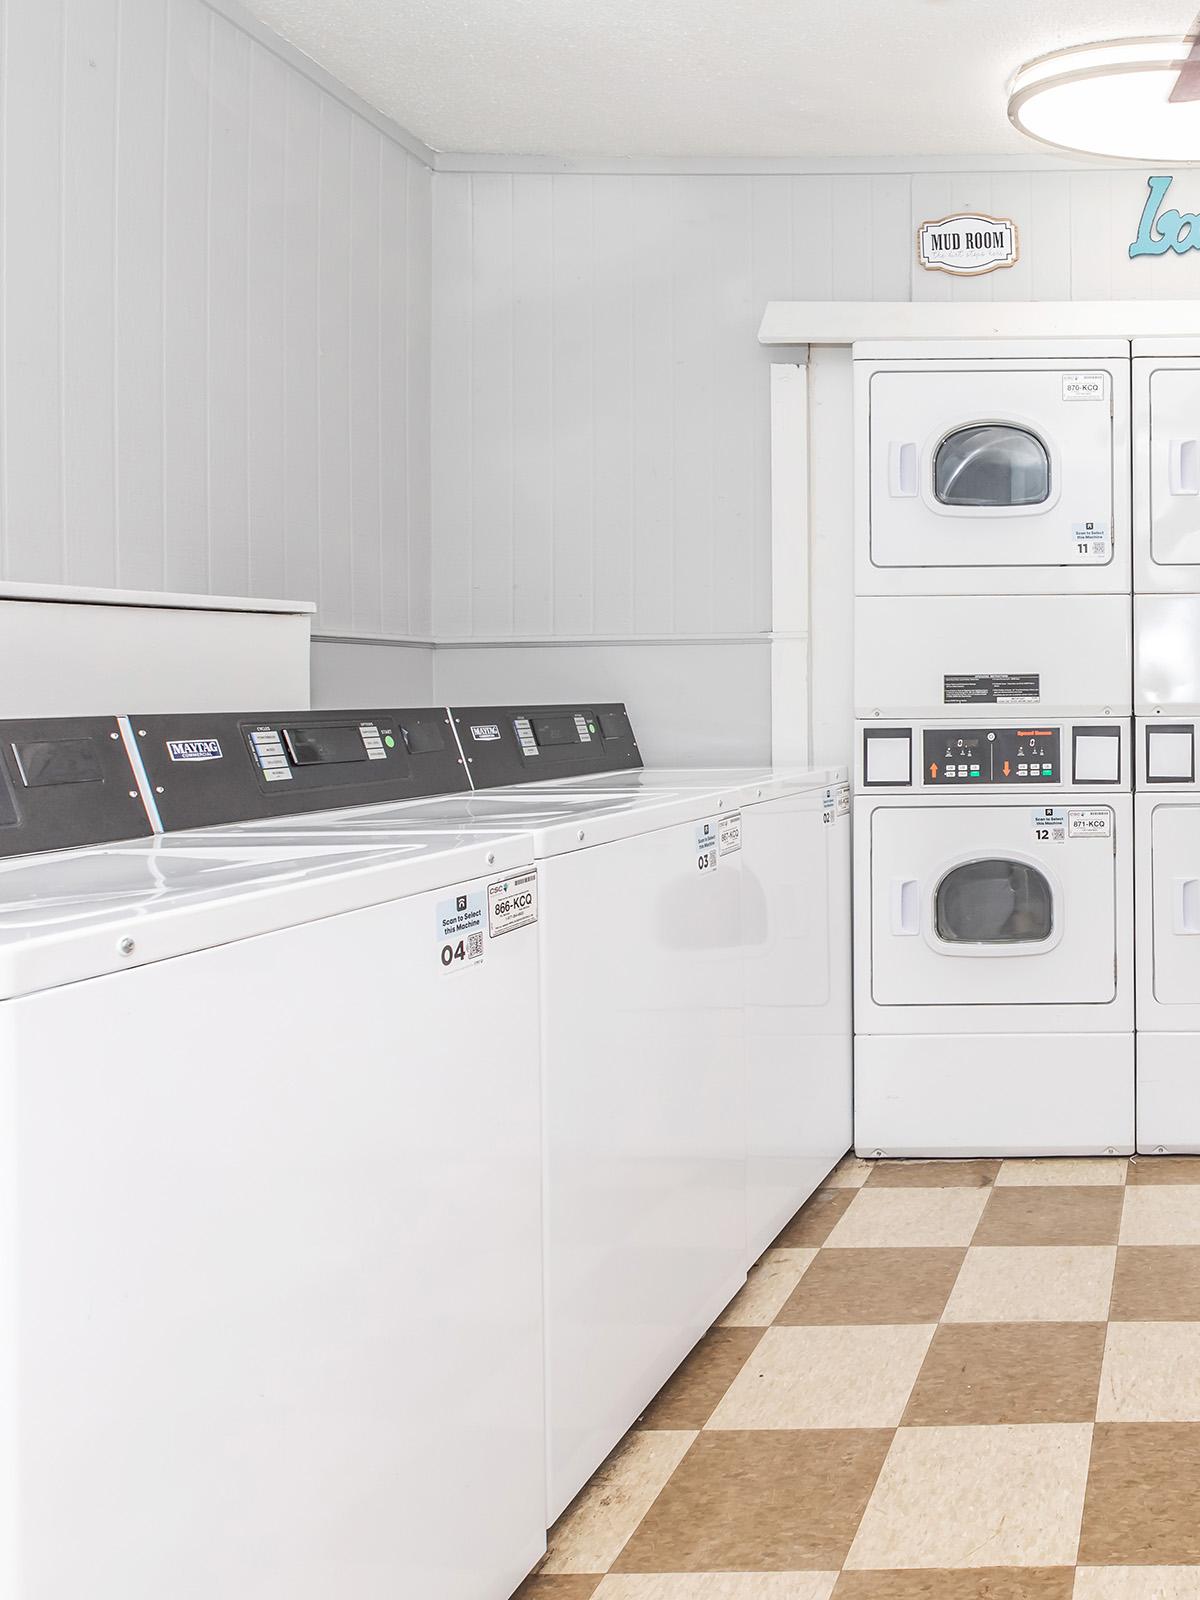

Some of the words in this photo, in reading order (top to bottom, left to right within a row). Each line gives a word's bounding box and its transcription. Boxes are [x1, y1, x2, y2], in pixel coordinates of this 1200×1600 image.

[931, 233, 960, 250] MUD
[966, 232, 1004, 249] ROOM
[1077, 543, 1088, 553] 11
[171, 742, 218, 755] MAYTAG
[1036, 830, 1049, 840] 12
[698, 854, 709, 870] 03
[495, 893, 532, 915] 866-KCQ
[442, 918, 457, 927] Scan
[465, 909, 481, 920] Select
[456, 919, 480, 931] Machine
[441, 940, 465, 966] 04
